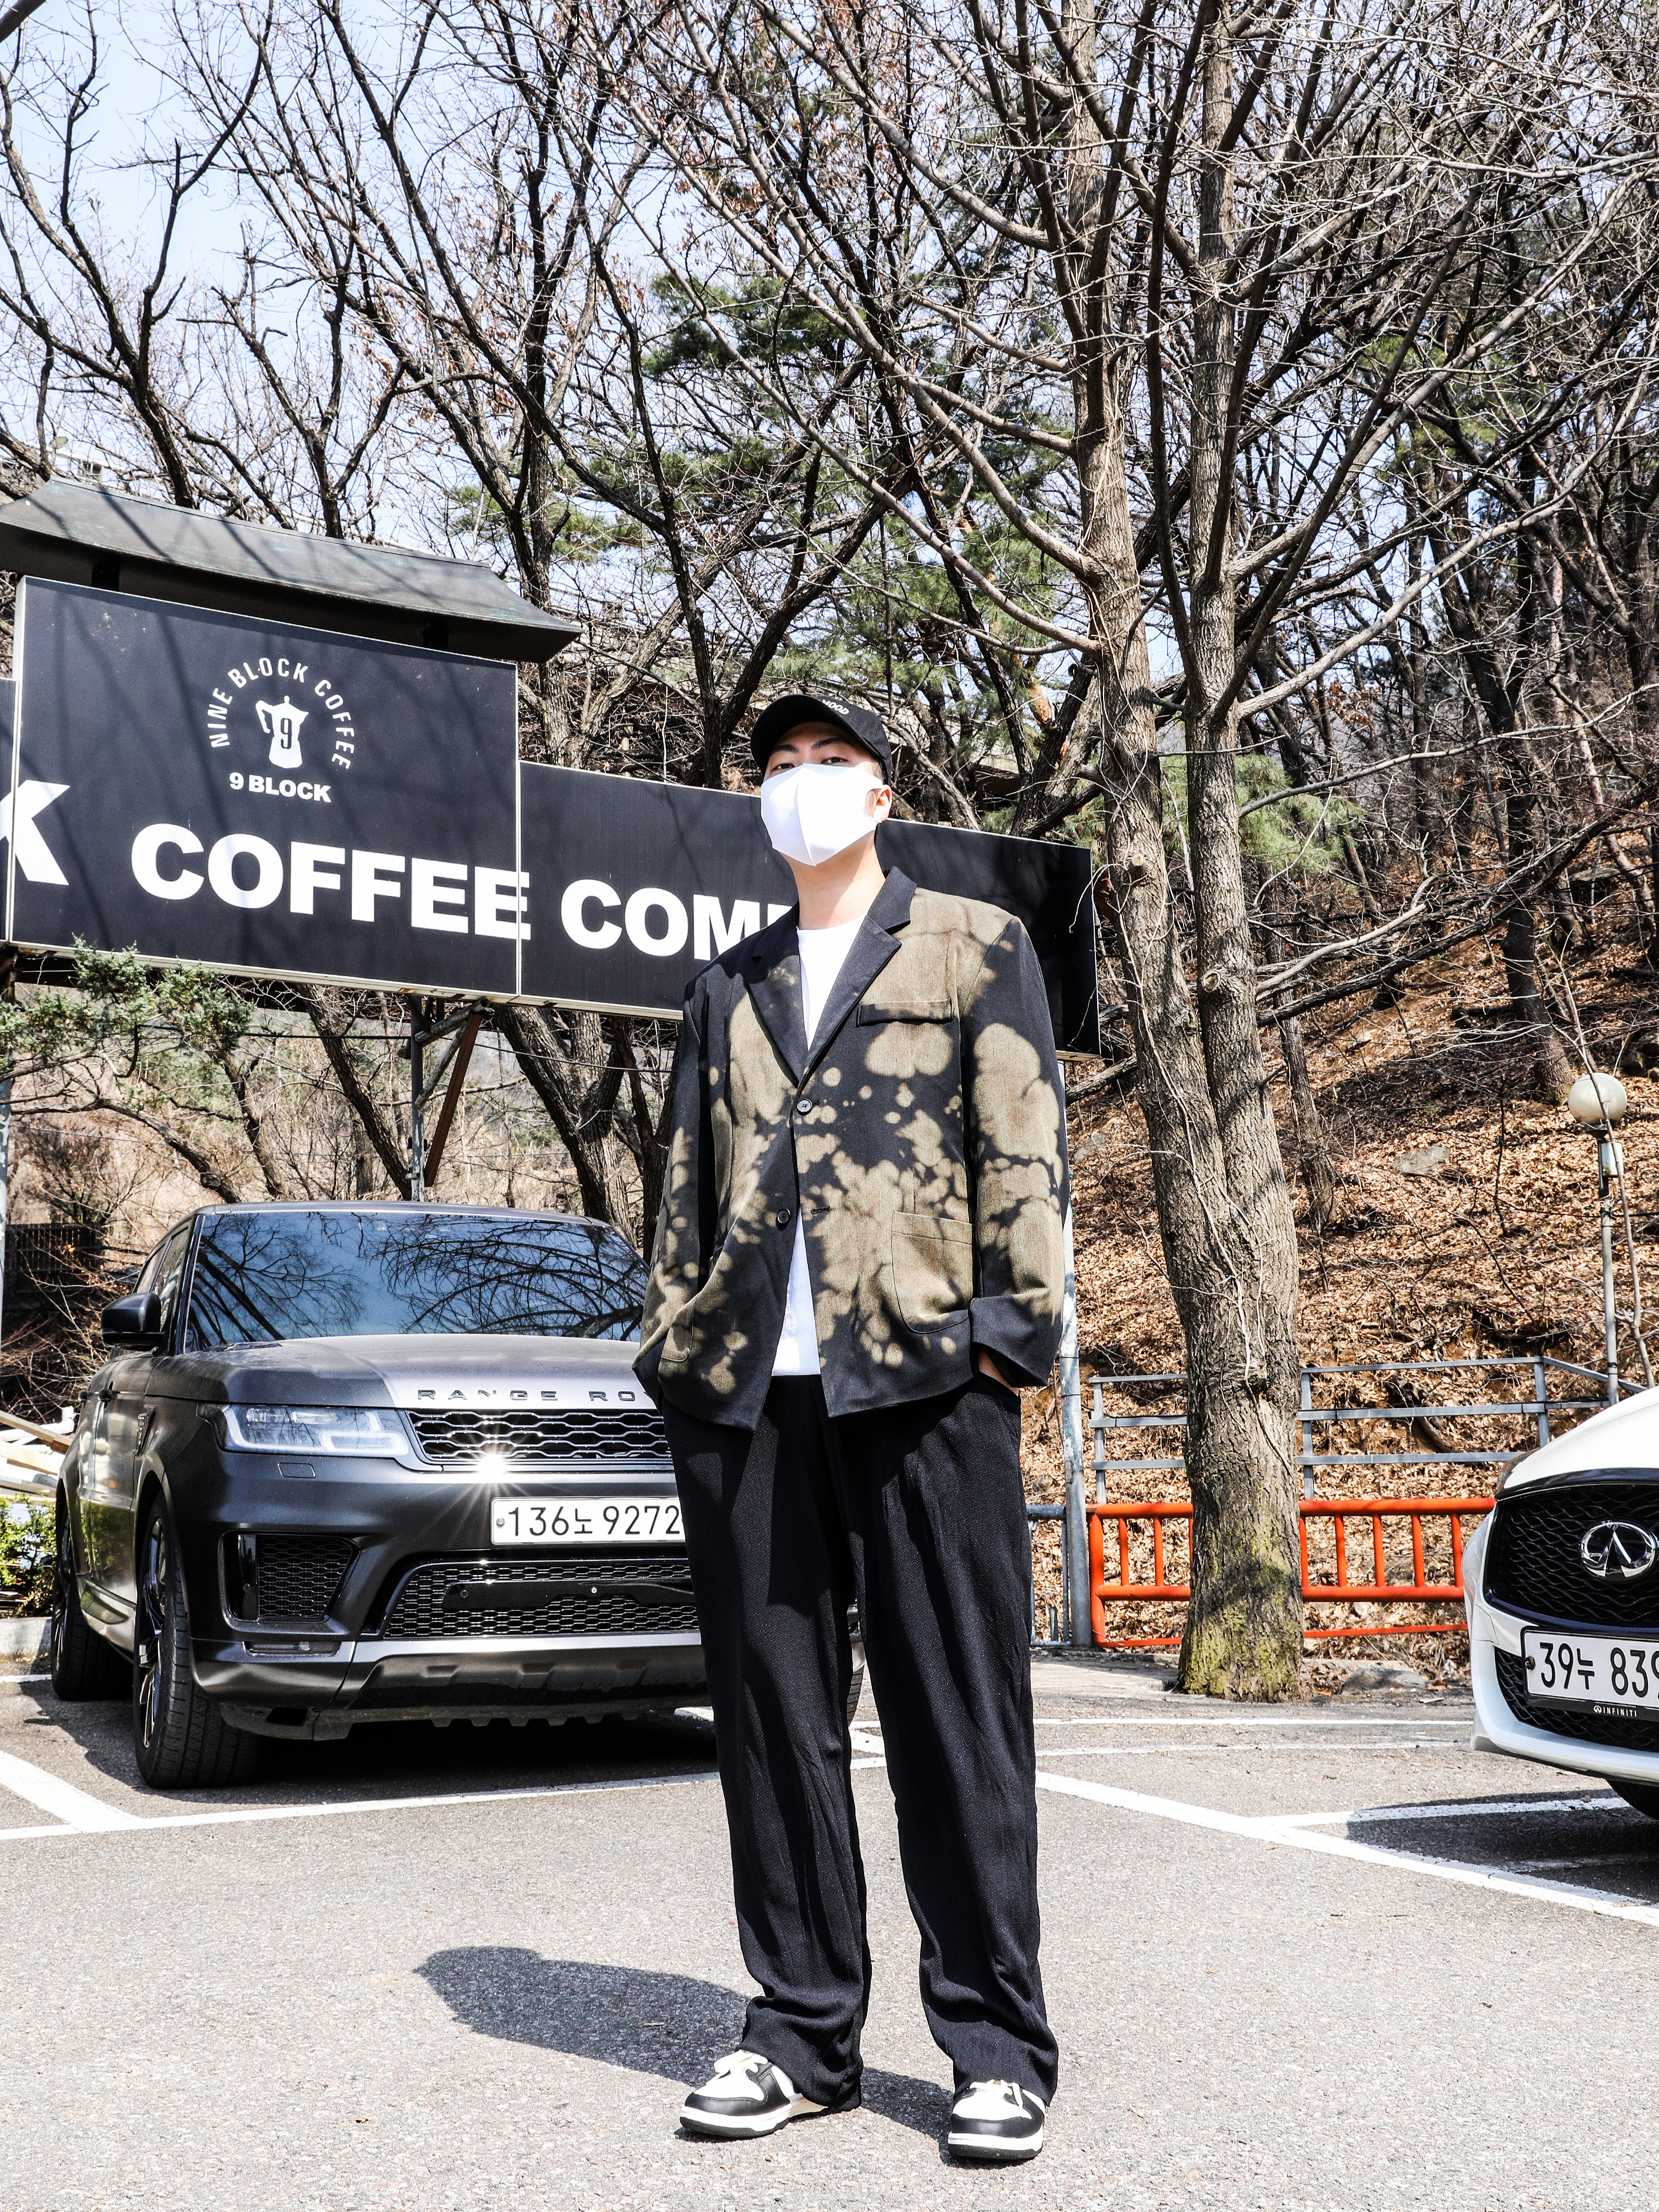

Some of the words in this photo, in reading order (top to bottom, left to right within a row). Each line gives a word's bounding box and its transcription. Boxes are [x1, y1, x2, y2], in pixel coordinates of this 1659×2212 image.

[207, 688, 233, 748] NINE
[228, 657, 309, 688] BLOCK
[314, 679, 355, 769] COFFEE
[280, 717, 292, 750] 9
[229, 772, 245, 790] 9
[248, 774, 332, 803] BLOCK
[131, 823, 531, 941] COFFEE
[417, 1389, 558, 1401] RANGE
[588, 1390, 648, 1401] RO
[508, 1506, 593, 1537] 136노
[602, 1505, 680, 1535] 9272
[1540, 1642, 1595, 1690] 39누
[1603, 1706, 1637, 1717] INFINITI
